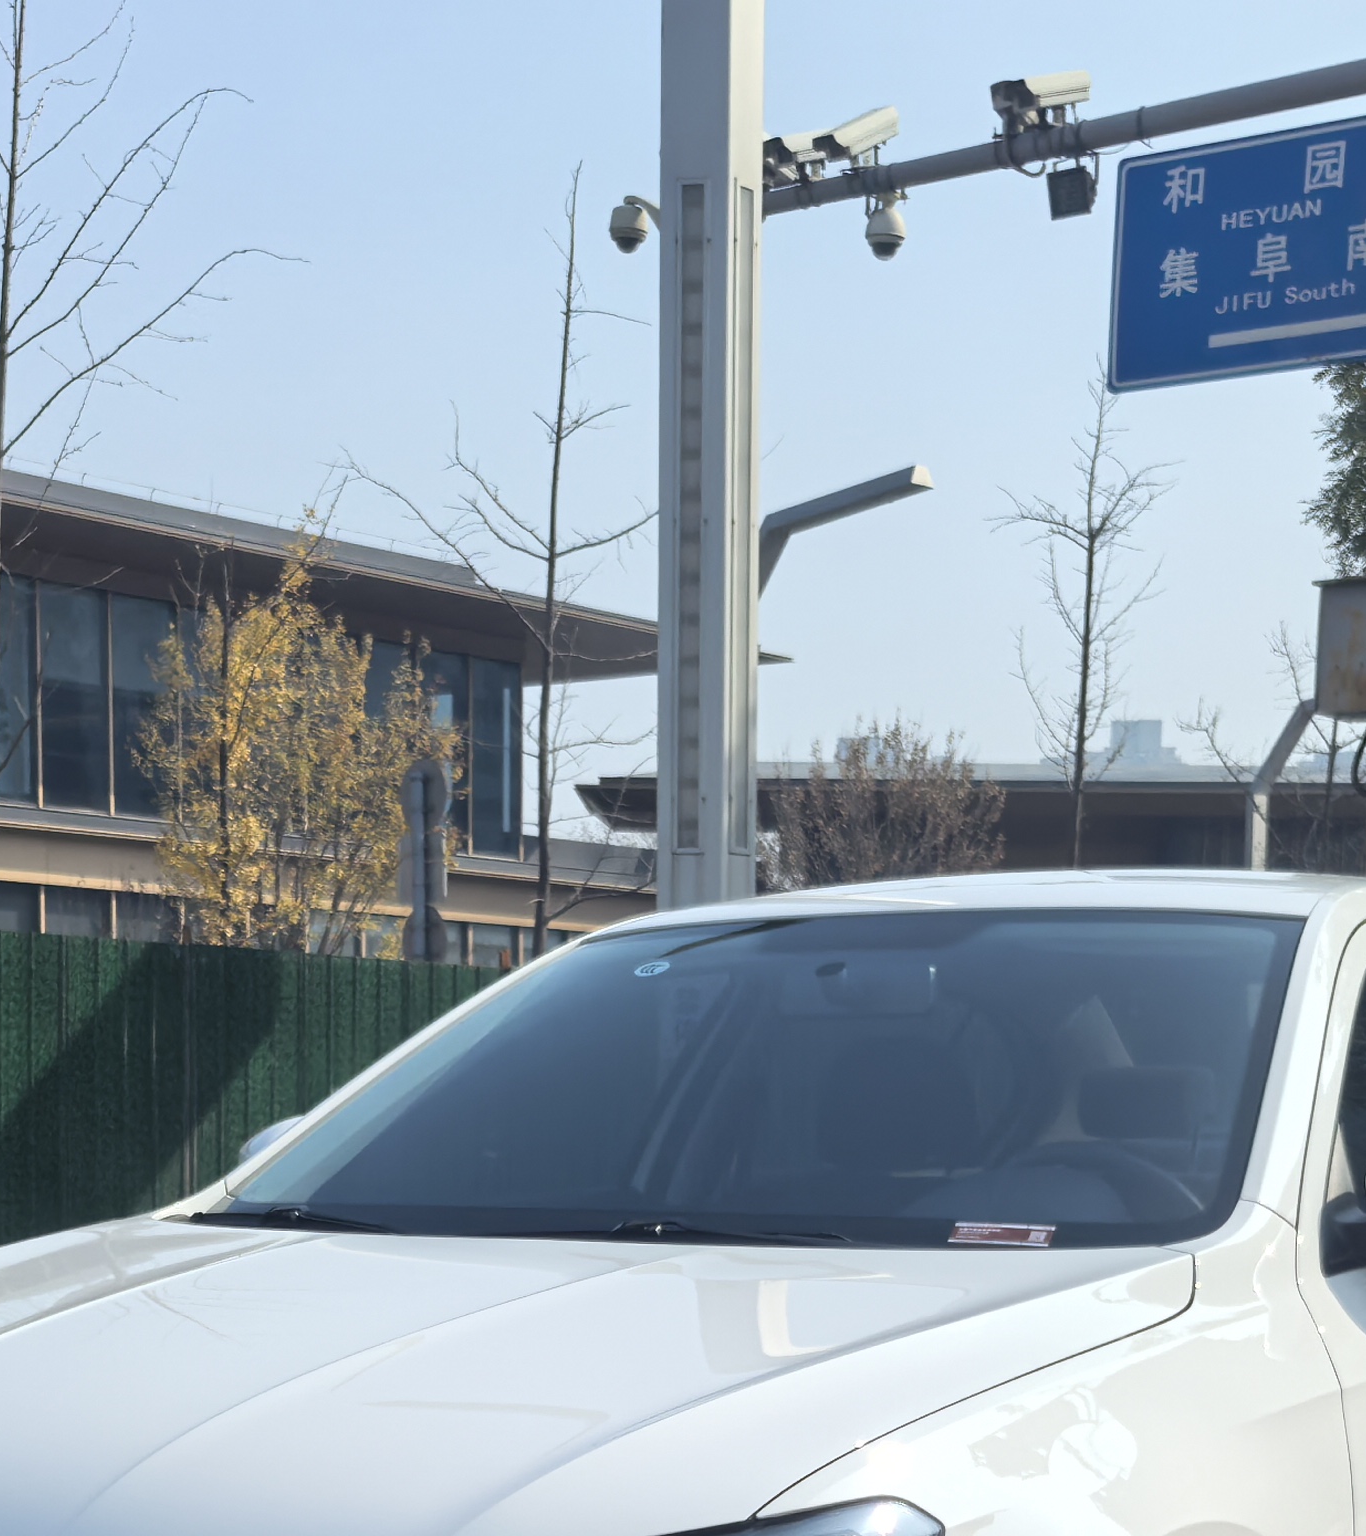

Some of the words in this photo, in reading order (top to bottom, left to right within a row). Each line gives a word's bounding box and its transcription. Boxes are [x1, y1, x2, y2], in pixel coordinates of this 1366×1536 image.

[1220, 198, 1323, 231] HEYUAN
[1214, 290, 1273, 315] JIFU
[1284, 278, 1356, 306] South
